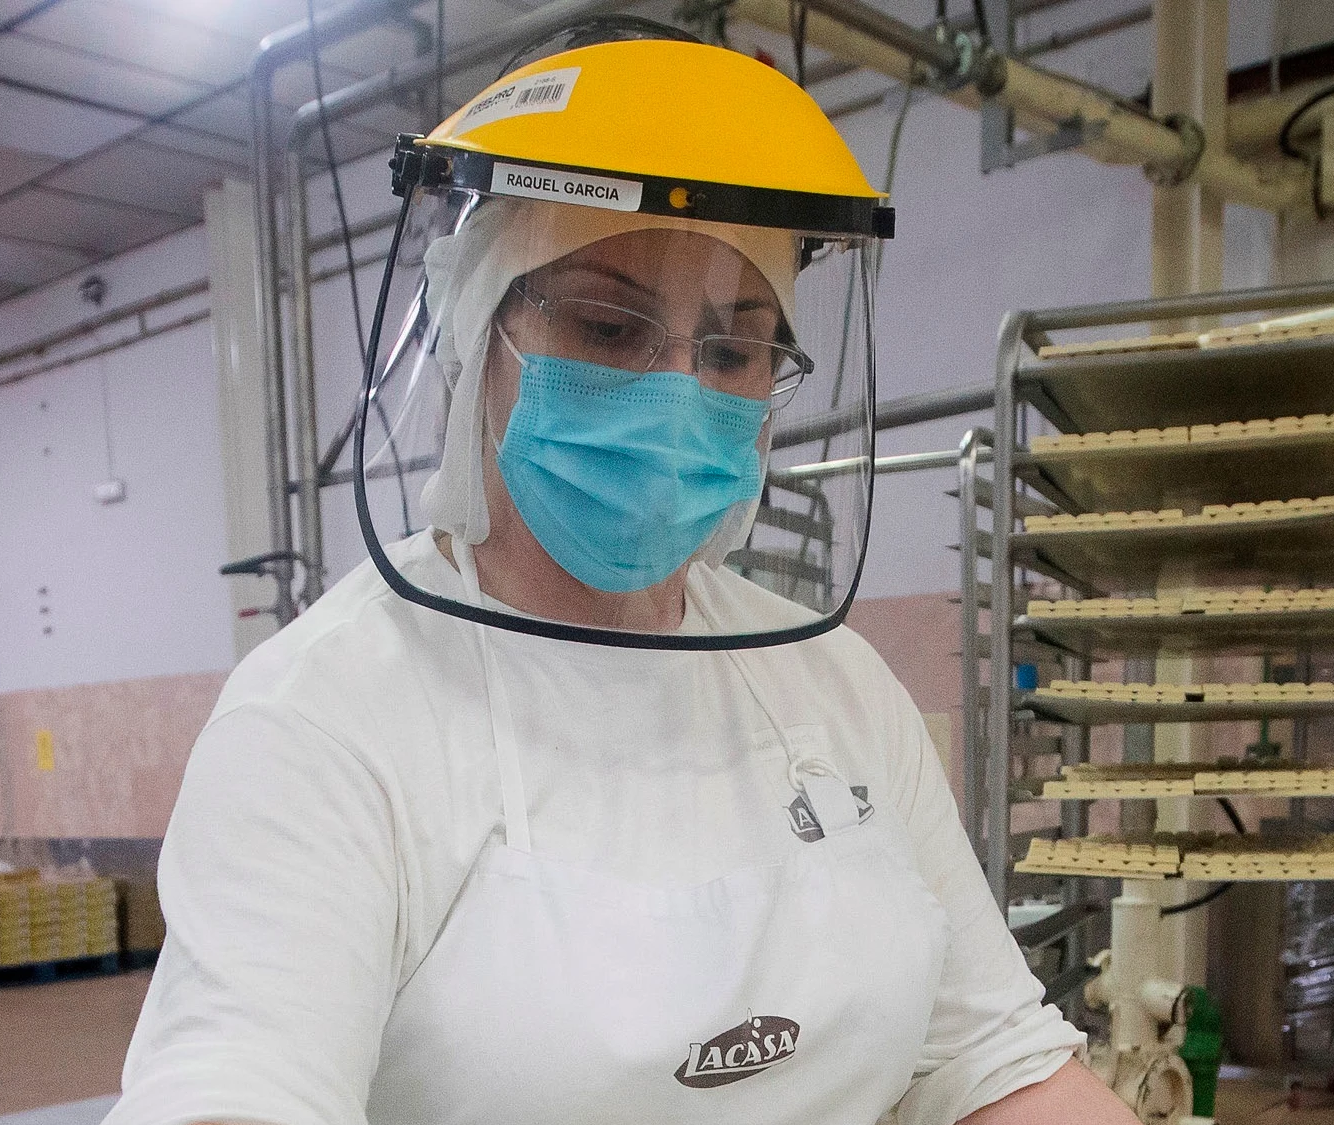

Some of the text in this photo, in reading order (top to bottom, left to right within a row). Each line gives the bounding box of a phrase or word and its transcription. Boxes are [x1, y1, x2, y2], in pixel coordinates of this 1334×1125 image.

[507, 173, 620, 201] RAQUEL GARCIA
[684, 1031, 795, 1077] LACASA
